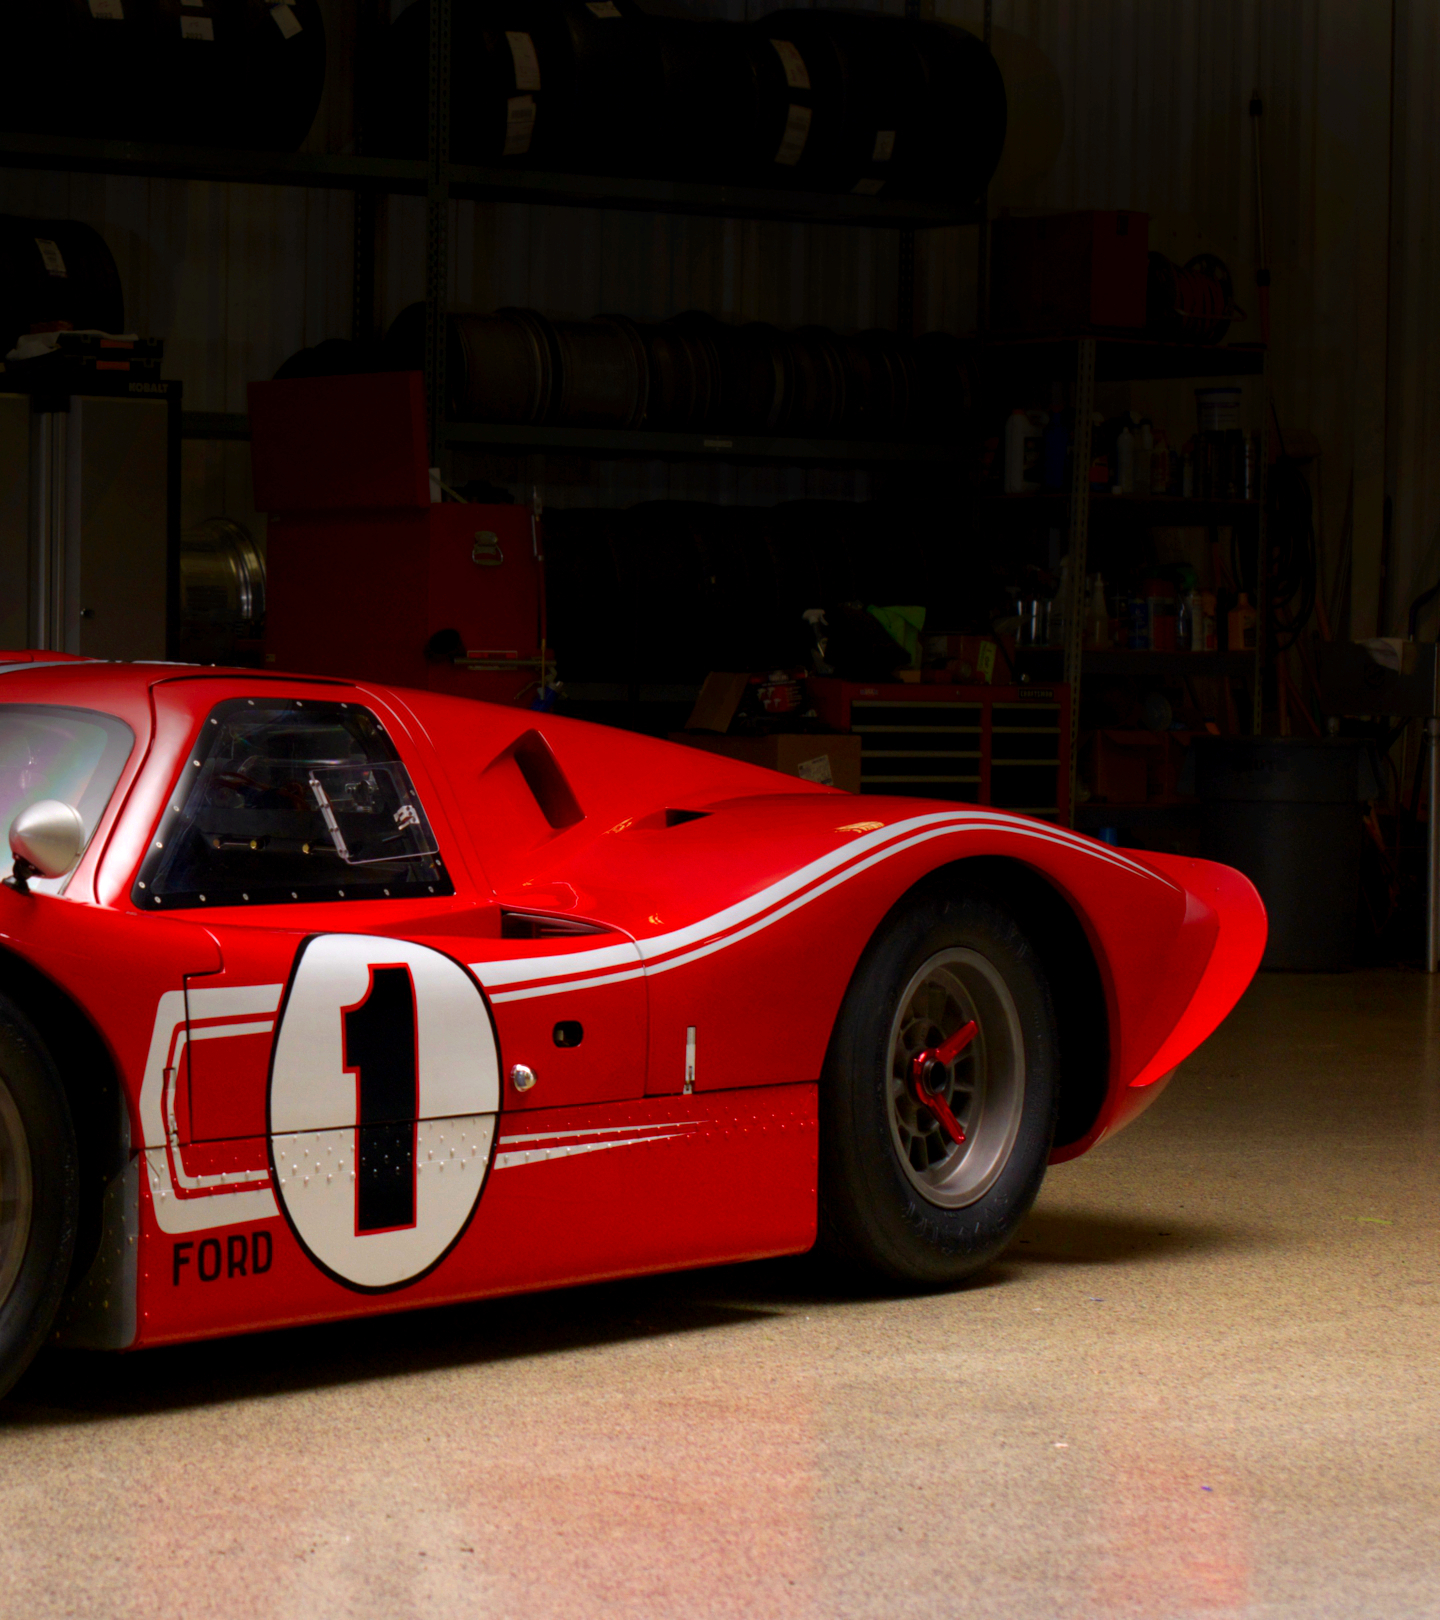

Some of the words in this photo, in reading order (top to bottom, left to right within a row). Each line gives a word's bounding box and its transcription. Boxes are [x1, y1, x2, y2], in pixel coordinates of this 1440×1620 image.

[128, 382, 169, 394] KOBALT
[340, 962, 420, 1236] 1
[172, 1230, 273, 1287] FORD
